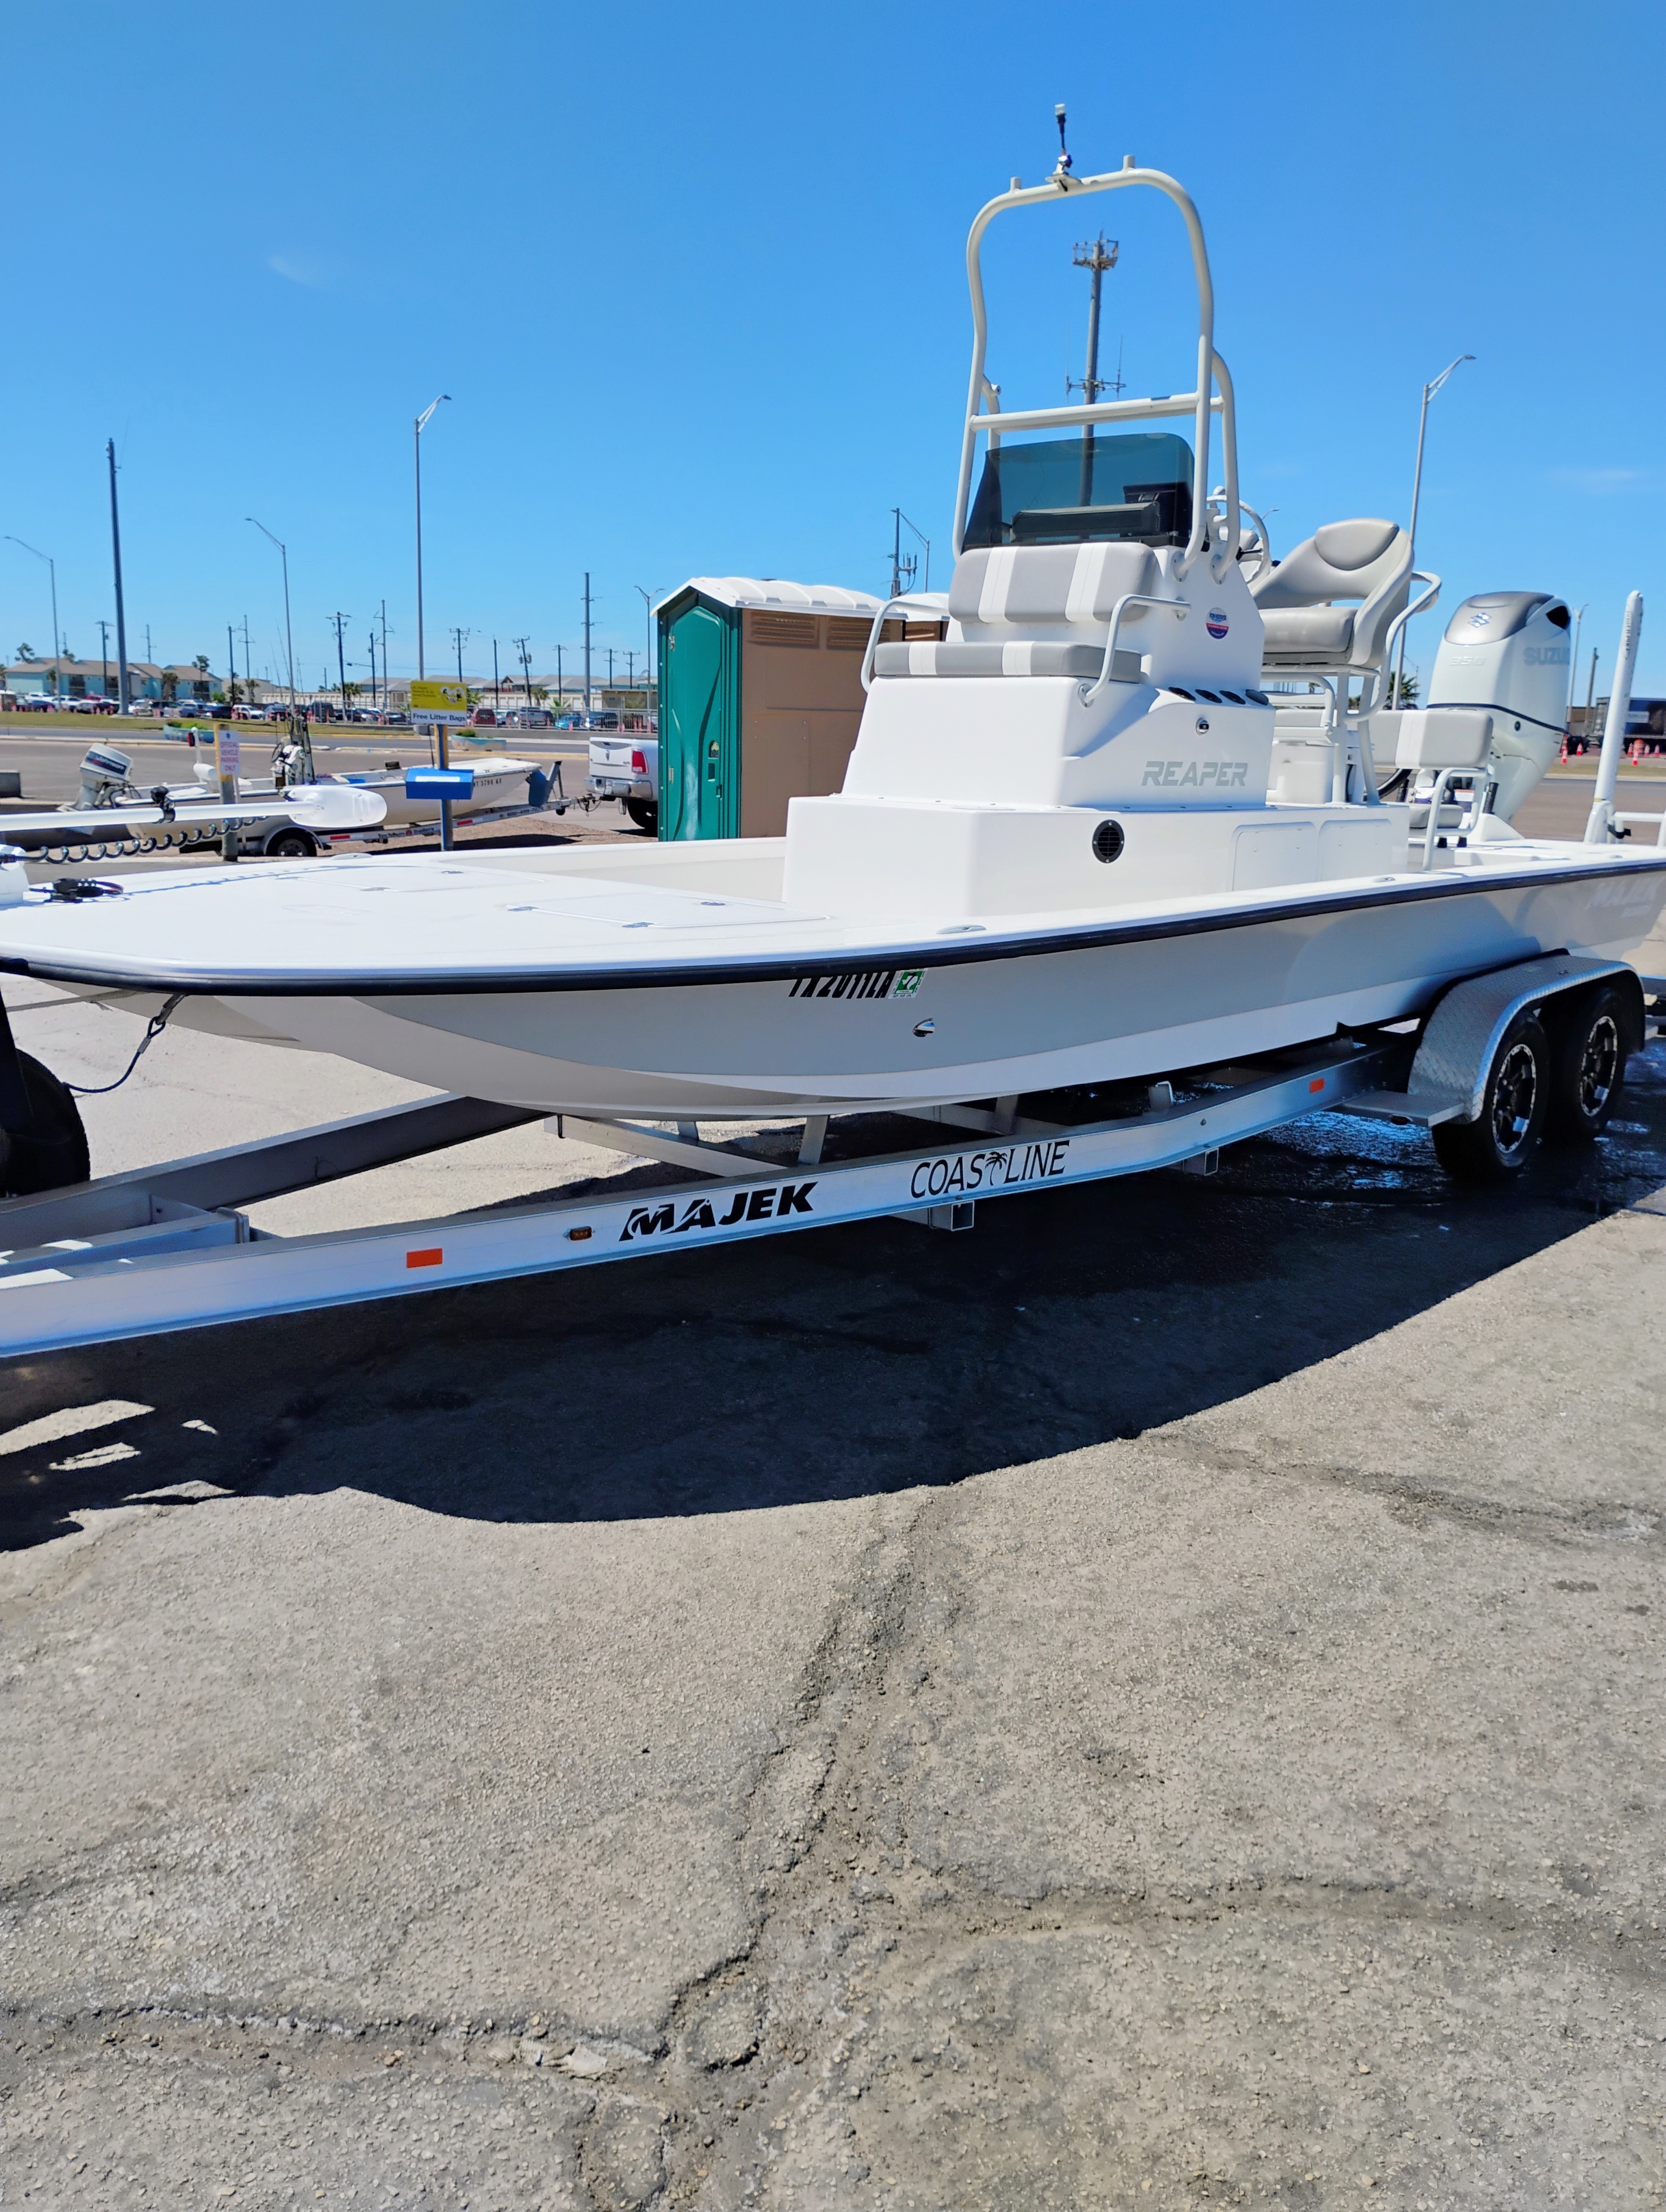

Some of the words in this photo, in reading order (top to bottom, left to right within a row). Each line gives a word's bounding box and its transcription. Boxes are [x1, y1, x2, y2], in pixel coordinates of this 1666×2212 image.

[1450, 656, 1486, 666] 350
[1524, 647, 1570, 665] SUZU
[1141, 761, 1248, 786] REAPER
[619, 1181, 819, 1242] MAJEK
